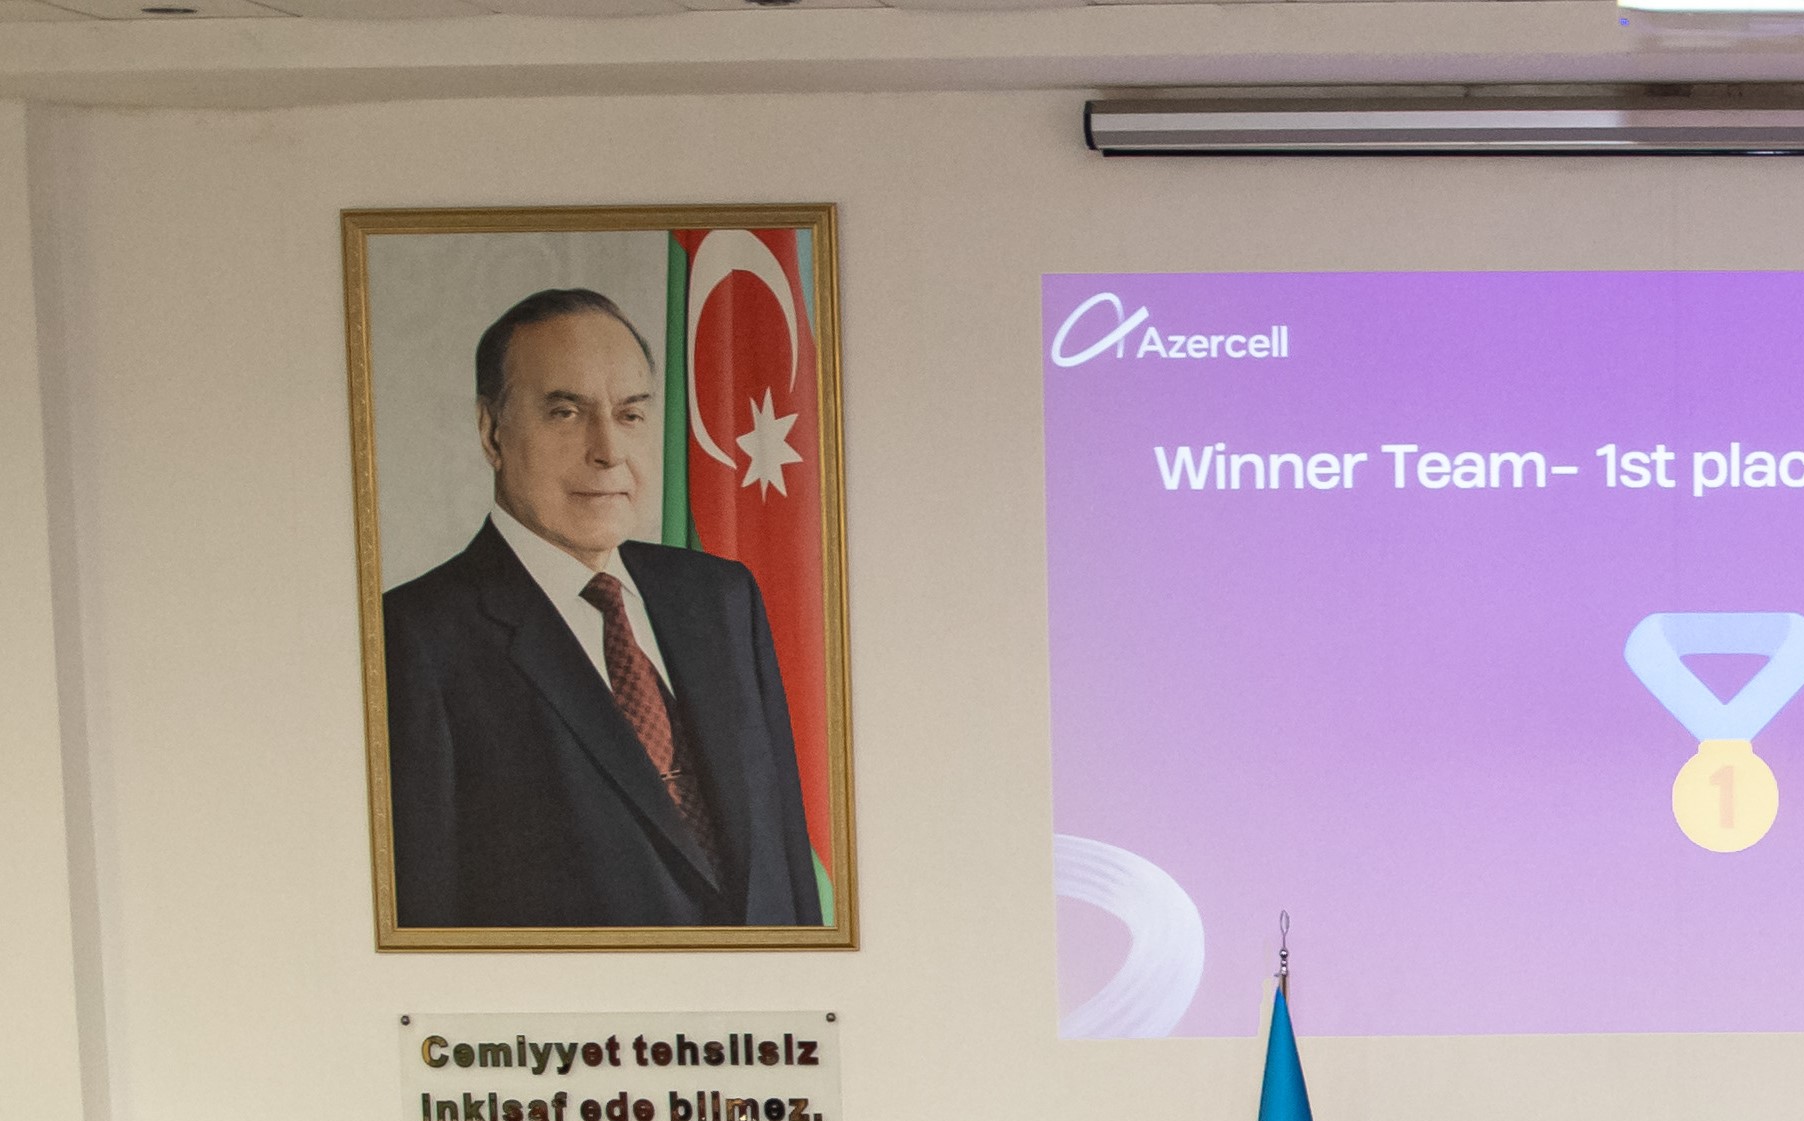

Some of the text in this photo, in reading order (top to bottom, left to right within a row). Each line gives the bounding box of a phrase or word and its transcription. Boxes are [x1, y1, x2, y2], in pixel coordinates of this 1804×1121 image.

[1136, 324, 1289, 359] Azercell
[1153, 443, 1367, 491] Winner
[1595, 443, 1676, 488] 1st
